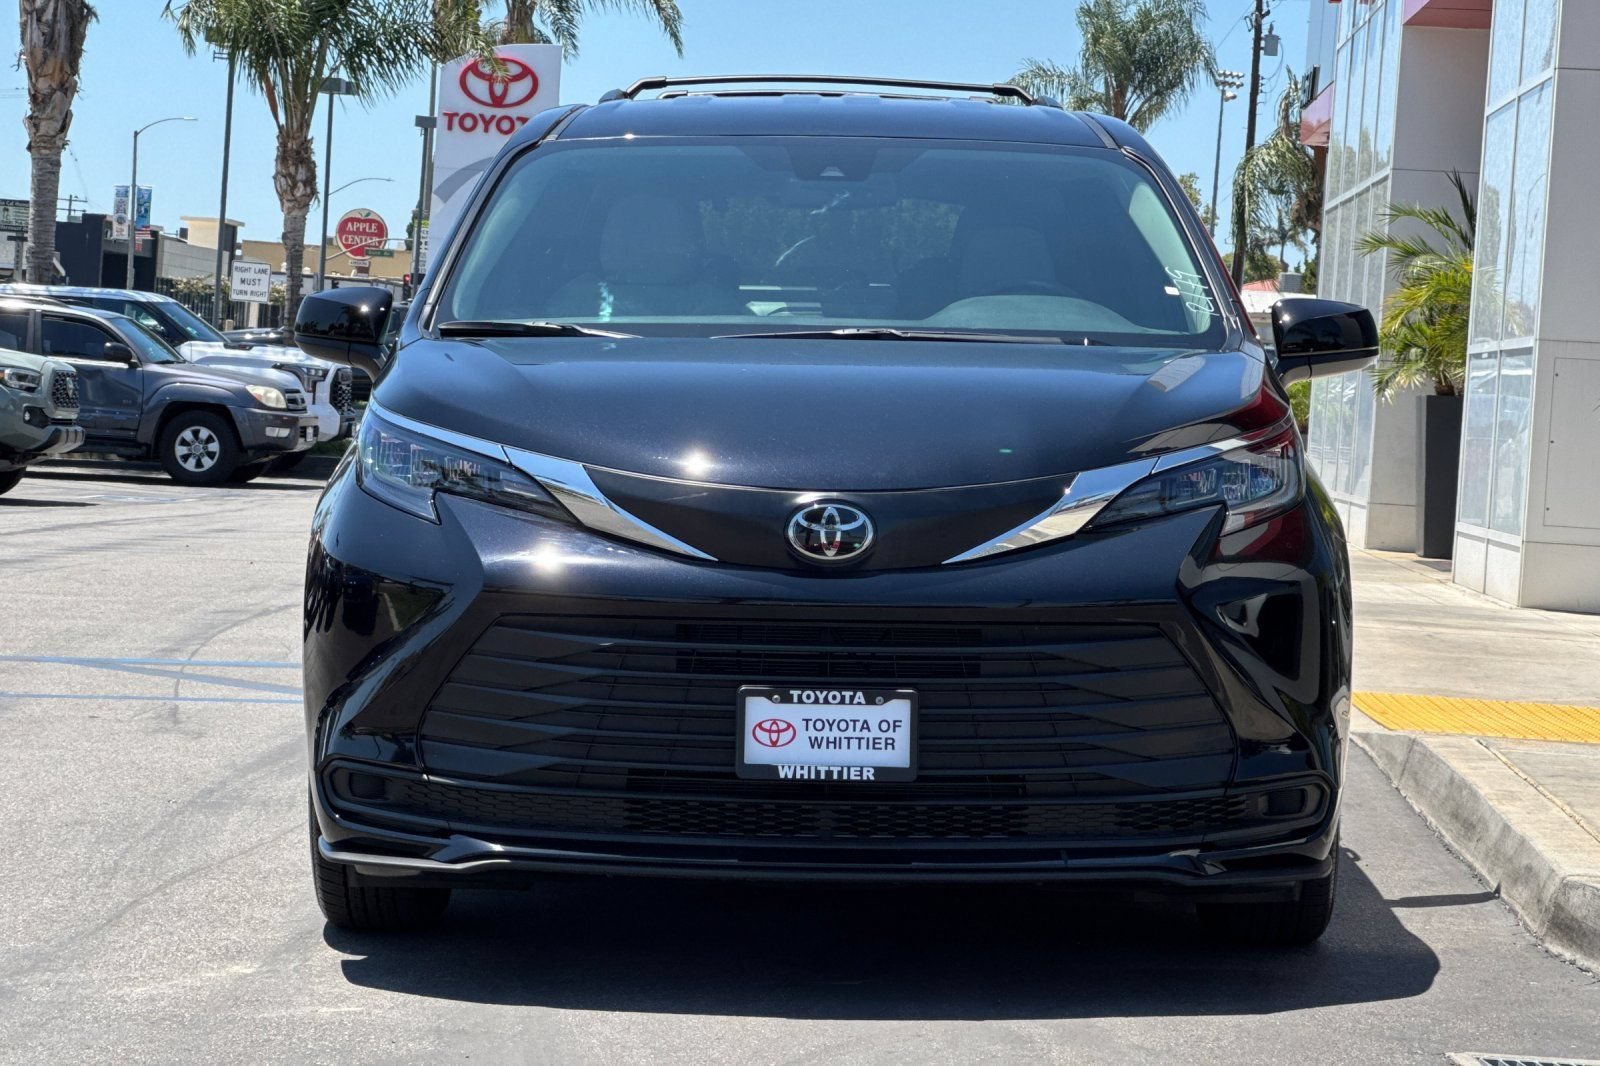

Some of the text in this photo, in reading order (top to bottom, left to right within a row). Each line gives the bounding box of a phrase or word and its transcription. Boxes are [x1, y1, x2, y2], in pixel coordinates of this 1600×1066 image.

[346, 221, 378, 233] APPLE
[342, 234, 380, 246] CENTER
[234, 265, 269, 275] RIGHT LANE
[240, 277, 261, 286] MUST
[232, 288, 267, 298] TURN RIGHT
[789, 690, 866, 704] TOYOTA
[802, 718, 903, 733] TOYOTA OF
[808, 736, 896, 751] WHITTIER
[777, 765, 875, 780] WHITTIER
